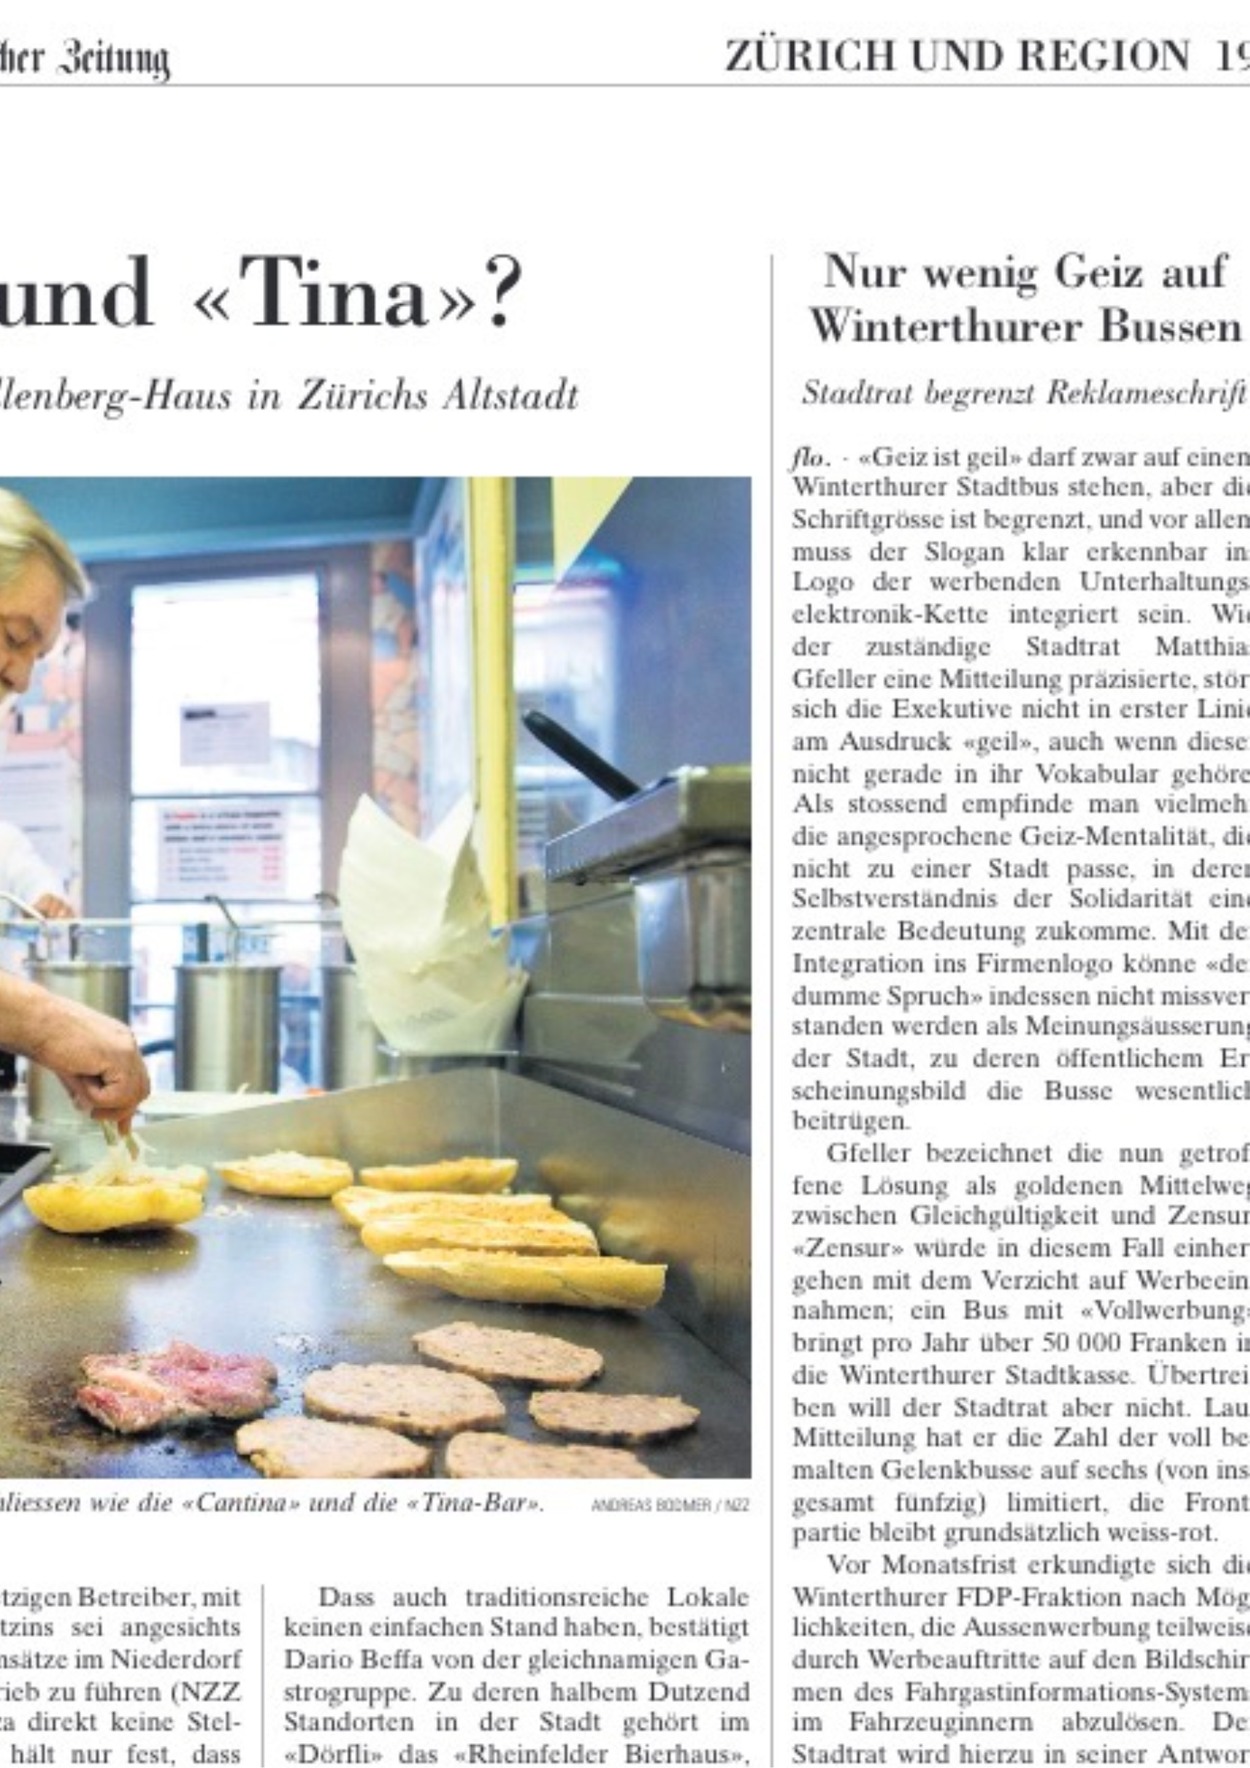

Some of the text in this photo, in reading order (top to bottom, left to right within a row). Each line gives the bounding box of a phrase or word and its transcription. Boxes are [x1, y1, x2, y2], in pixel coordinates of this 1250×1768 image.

[58, 37, 172, 83] Zeitung
[725, 30, 896, 72] ZÜRICH
[911, 39, 1005, 72] UND
[1018, 38, 1190, 72] REGION
[824, 251, 1230, 299] Nur wenig Geiz auf
[193, 253, 523, 329] «Tina»?
[808, 305, 1243, 343] Winterthurer Bussen
[248, 378, 280, 411] in
[297, 376, 428, 411] Zürichs
[441, 375, 579, 411] Altstadt
[801, 378, 1247, 413] Stadtrat begrenzt Reklameschrift
[787, 445, 831, 473] flo.
[858, 446, 929, 467] «Geiz
[933, 446, 961, 467] ist
[967, 445, 1022, 473] geil»
[1027, 445, 1078, 467] darf
[1081, 451, 1138, 467] zwar
[1143, 446, 1182, 467] auf
[90, 1492, 130, 1512] wie
[137, 1491, 173, 1513] die
[182, 1491, 301, 1513] «Cantina»
[309, 1491, 357, 1513] und
[363, 1491, 398, 1513] die
[407, 1491, 544, 1513] «Tina-Bar».
[591, 1498, 652, 1512] ANDREAS
[725, 1498, 750, 1512] NZZ
[792, 1521, 1219, 1550] partie bleibt grundsätzlich weiss-rot.
[78, 1586, 197, 1609] Betreiber,
[202, 1586, 241, 1608] mit
[319, 1586, 750, 1608] Dass auch traditionsreiche Lokale
[71, 1616, 104, 1637] sei
[120, 1616, 241, 1643] angesichts
[284, 1615, 750, 1643] keinen einfachen Stand haben, bestätigt
